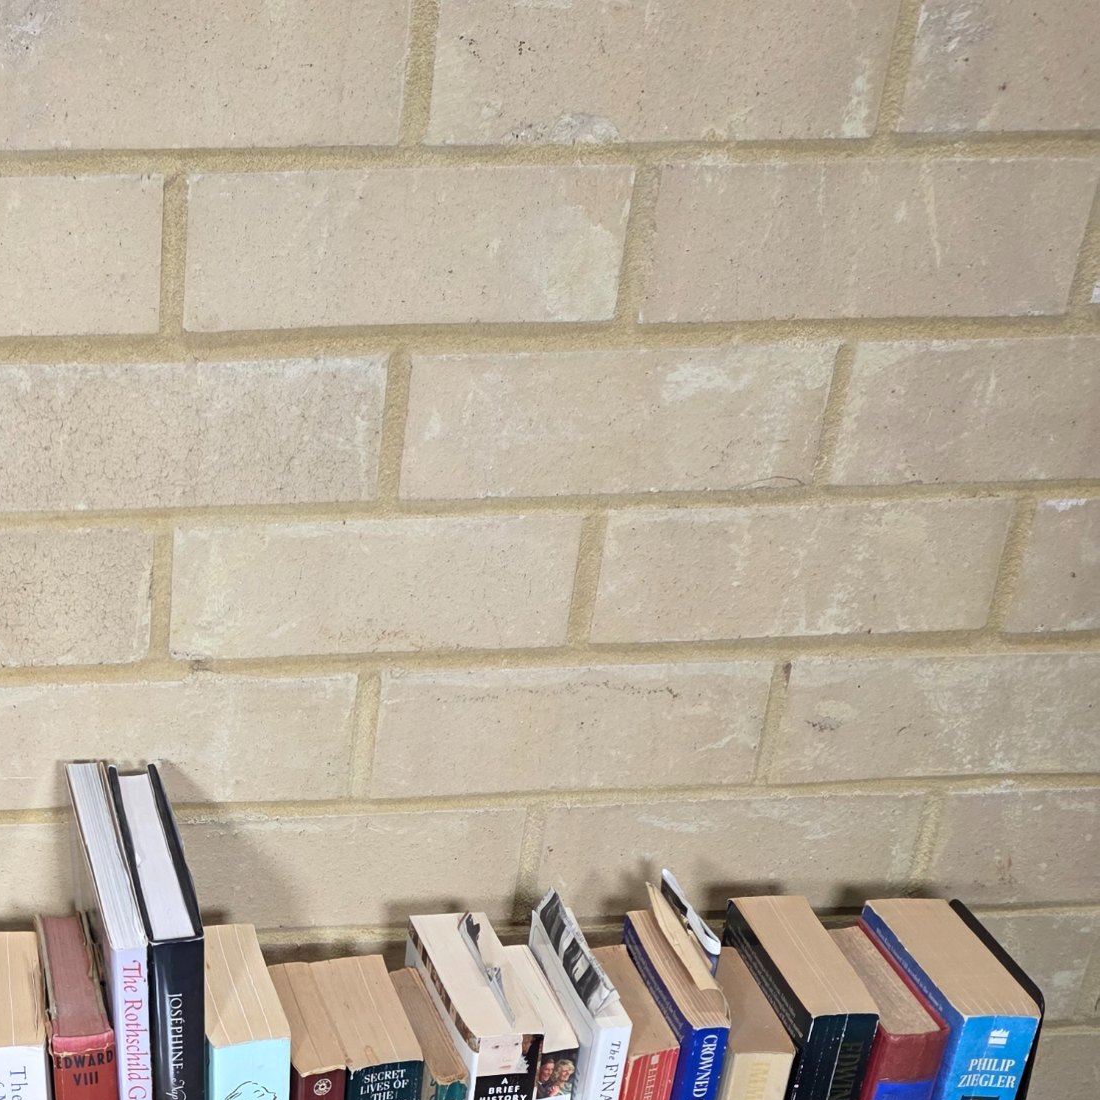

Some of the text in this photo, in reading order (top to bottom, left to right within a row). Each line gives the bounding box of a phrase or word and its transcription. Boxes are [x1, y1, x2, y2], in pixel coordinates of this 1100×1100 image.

[122, 959, 146, 993] The
[123, 998, 150, 1082] Rothschild
[609, 1040, 622, 1061] The
[57, 1048, 114, 1071] EDWARD
[692, 1034, 718, 1097] CROWNED
[967, 1057, 1016, 1073] PHILIP
[72, 1070, 99, 1086] VIII
[364, 1069, 406, 1084] SECRET
[501, 1077, 509, 1085] A
[957, 1073, 1017, 1089] ZIEGLER
[360, 1078, 409, 1096] LIVES OF
[488, 1085, 520, 1095] BRIEF
